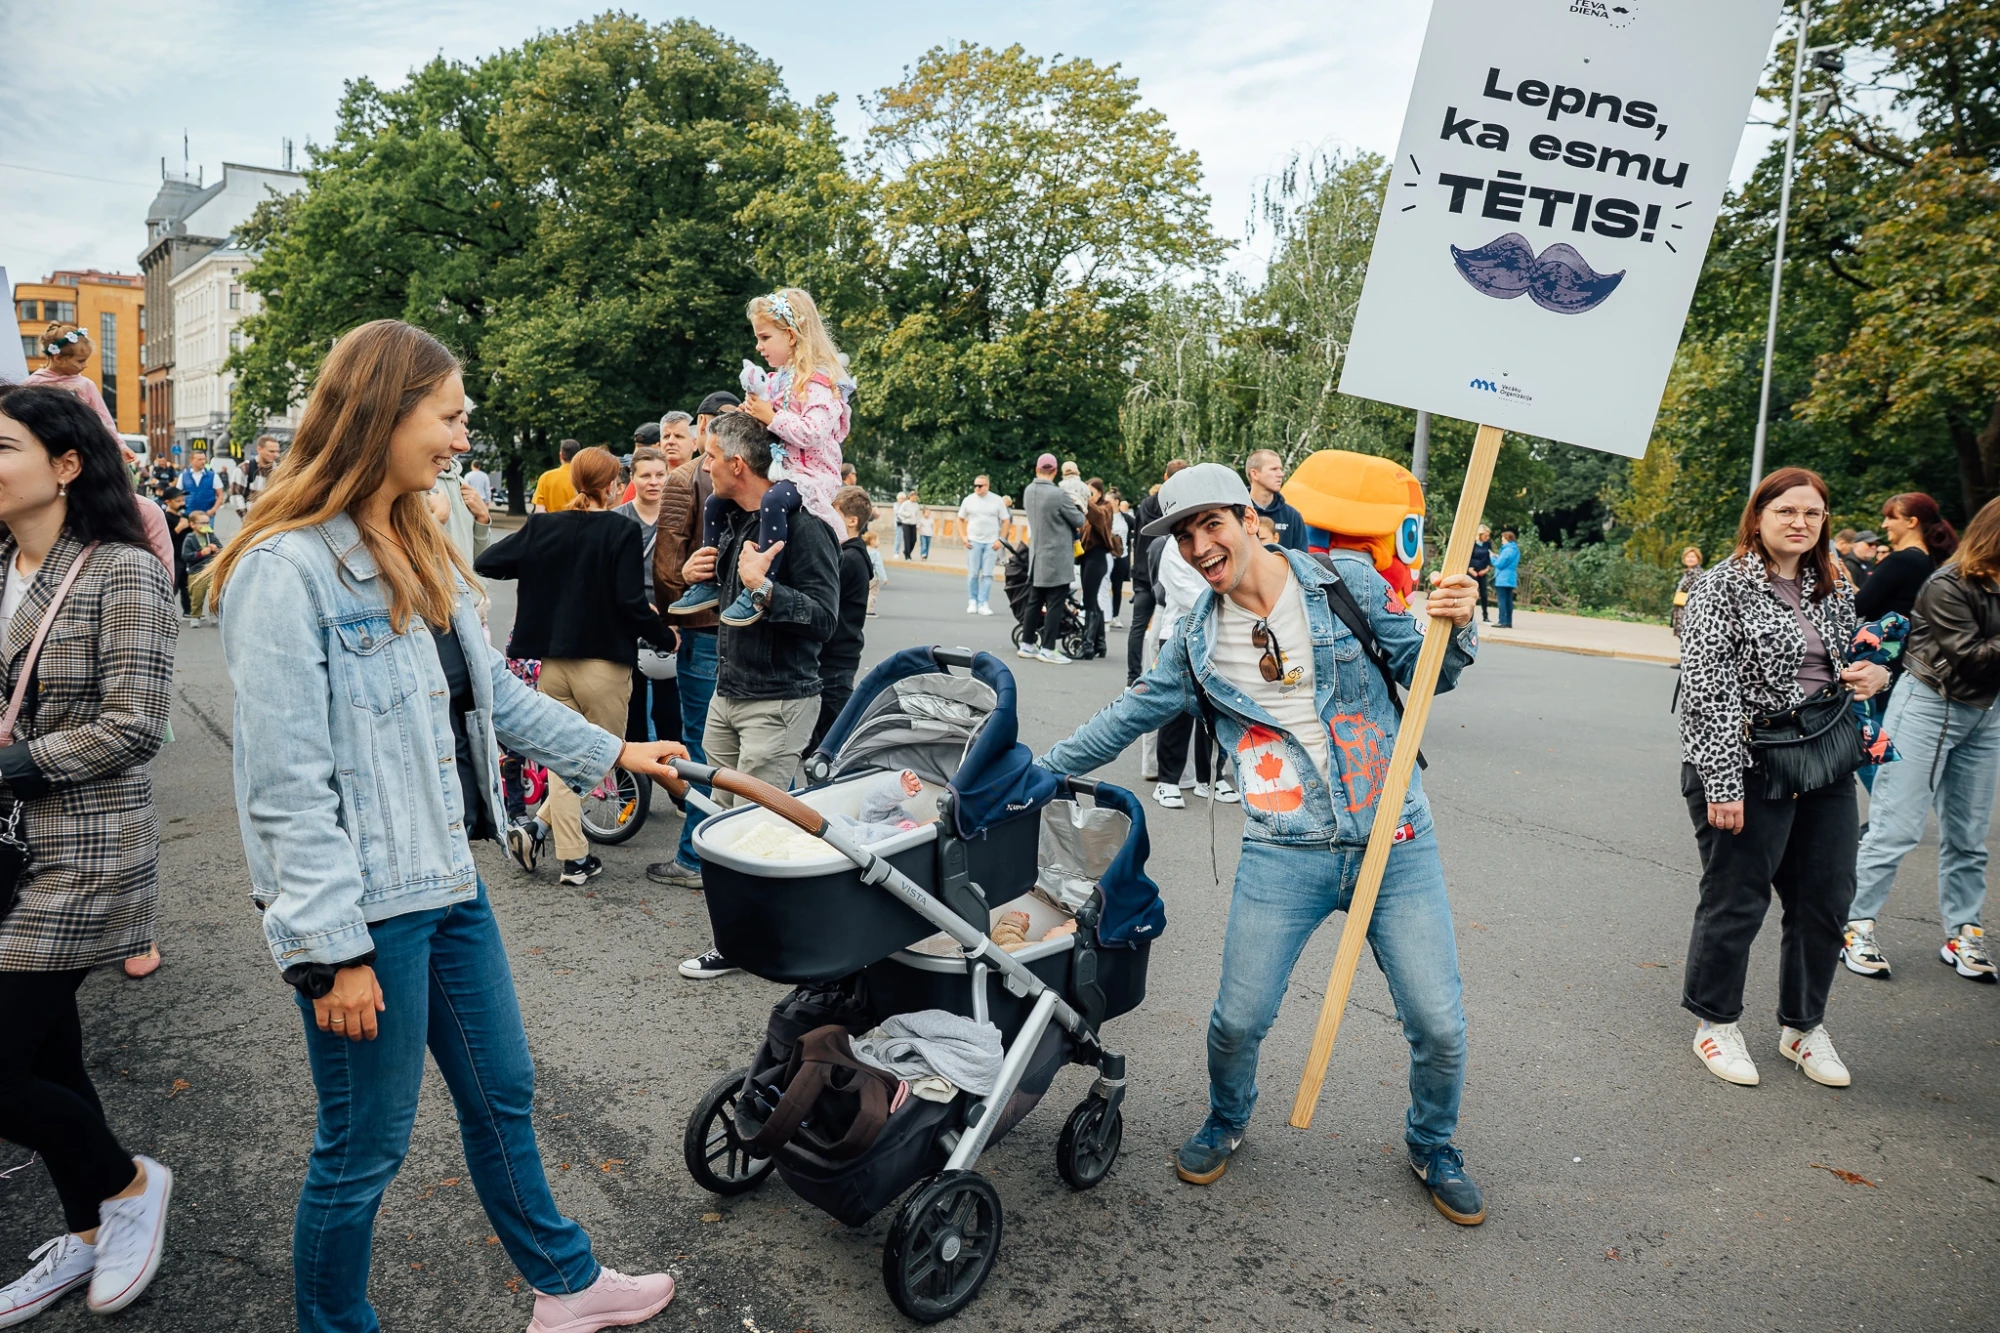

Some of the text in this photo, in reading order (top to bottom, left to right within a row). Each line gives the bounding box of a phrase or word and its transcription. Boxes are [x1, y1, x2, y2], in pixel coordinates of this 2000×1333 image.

[1569, 5, 1609, 19] DIENA
[1482, 66, 1668, 141] Lepns,
[1440, 106, 1690, 188] ka esmu
[1438, 169, 1662, 243] TĒTIS!
[901, 880, 928, 906] VISTA
